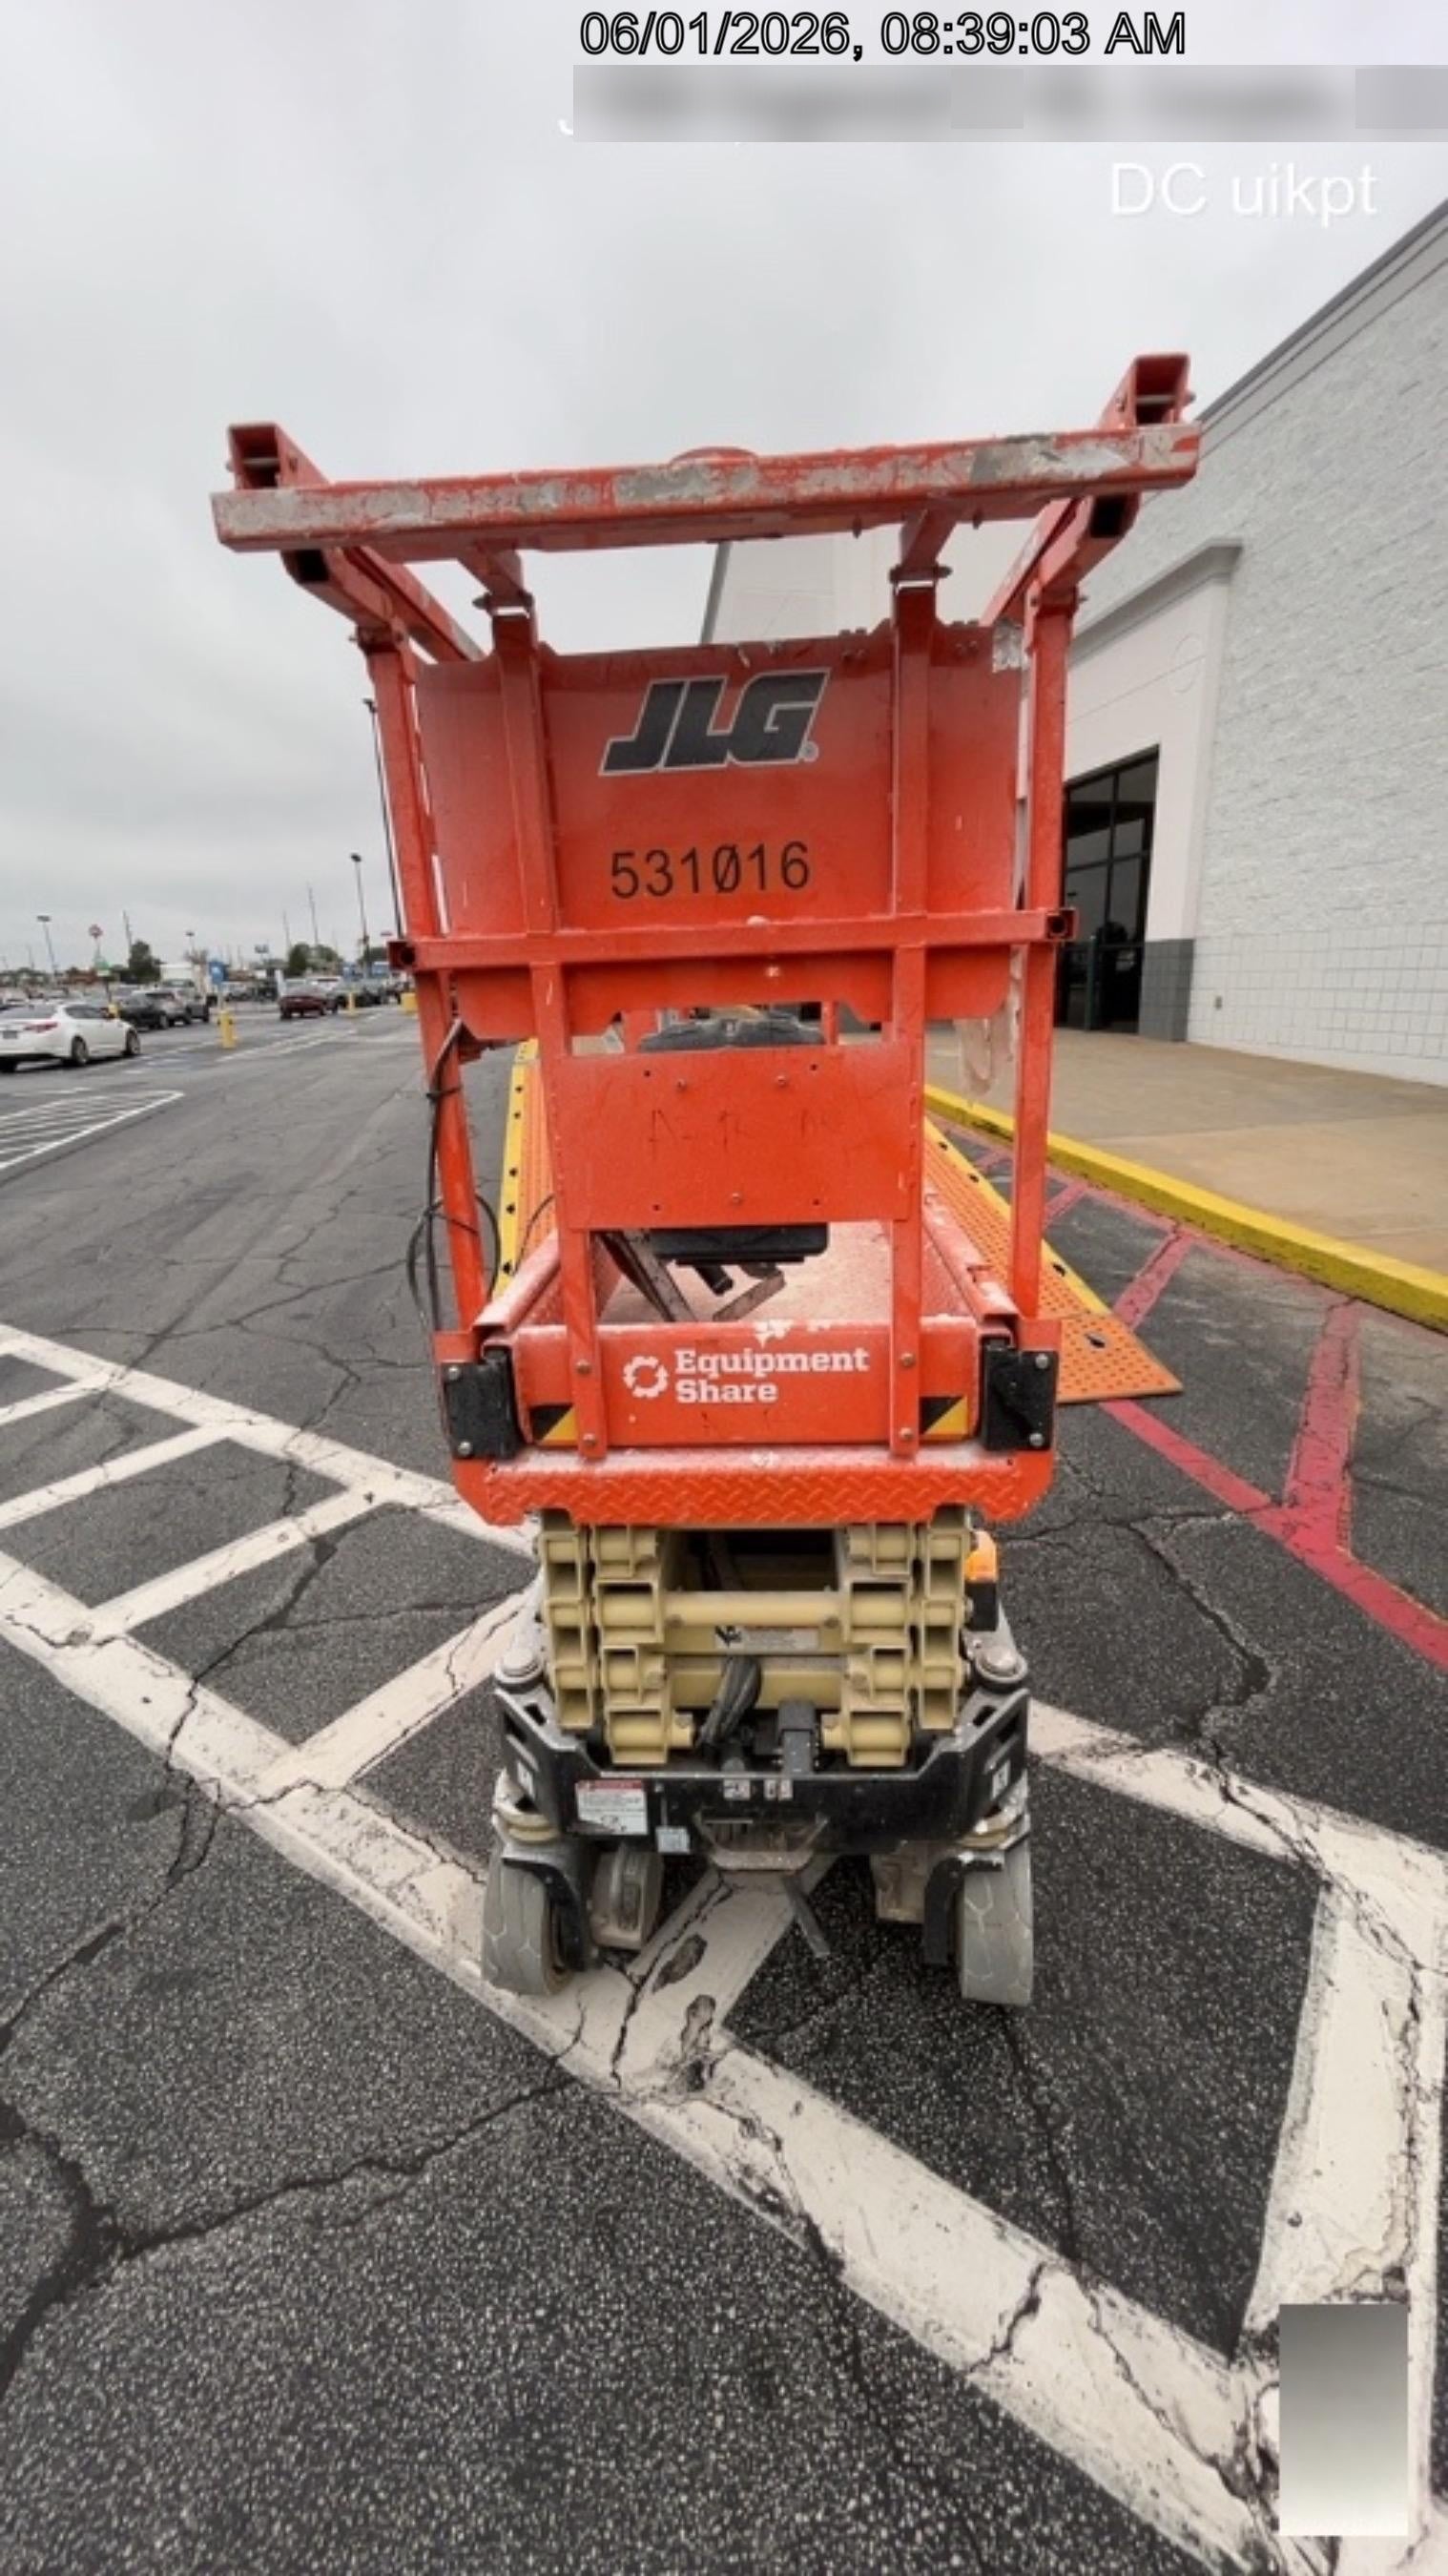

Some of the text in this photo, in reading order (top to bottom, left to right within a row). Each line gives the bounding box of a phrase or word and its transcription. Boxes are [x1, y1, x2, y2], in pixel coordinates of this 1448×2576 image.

[599, 669, 830, 777] JLG
[610, 841, 811, 900] 531016
[674, 1347, 870, 1379] Equipment
[675, 1379, 778, 1403] Share
